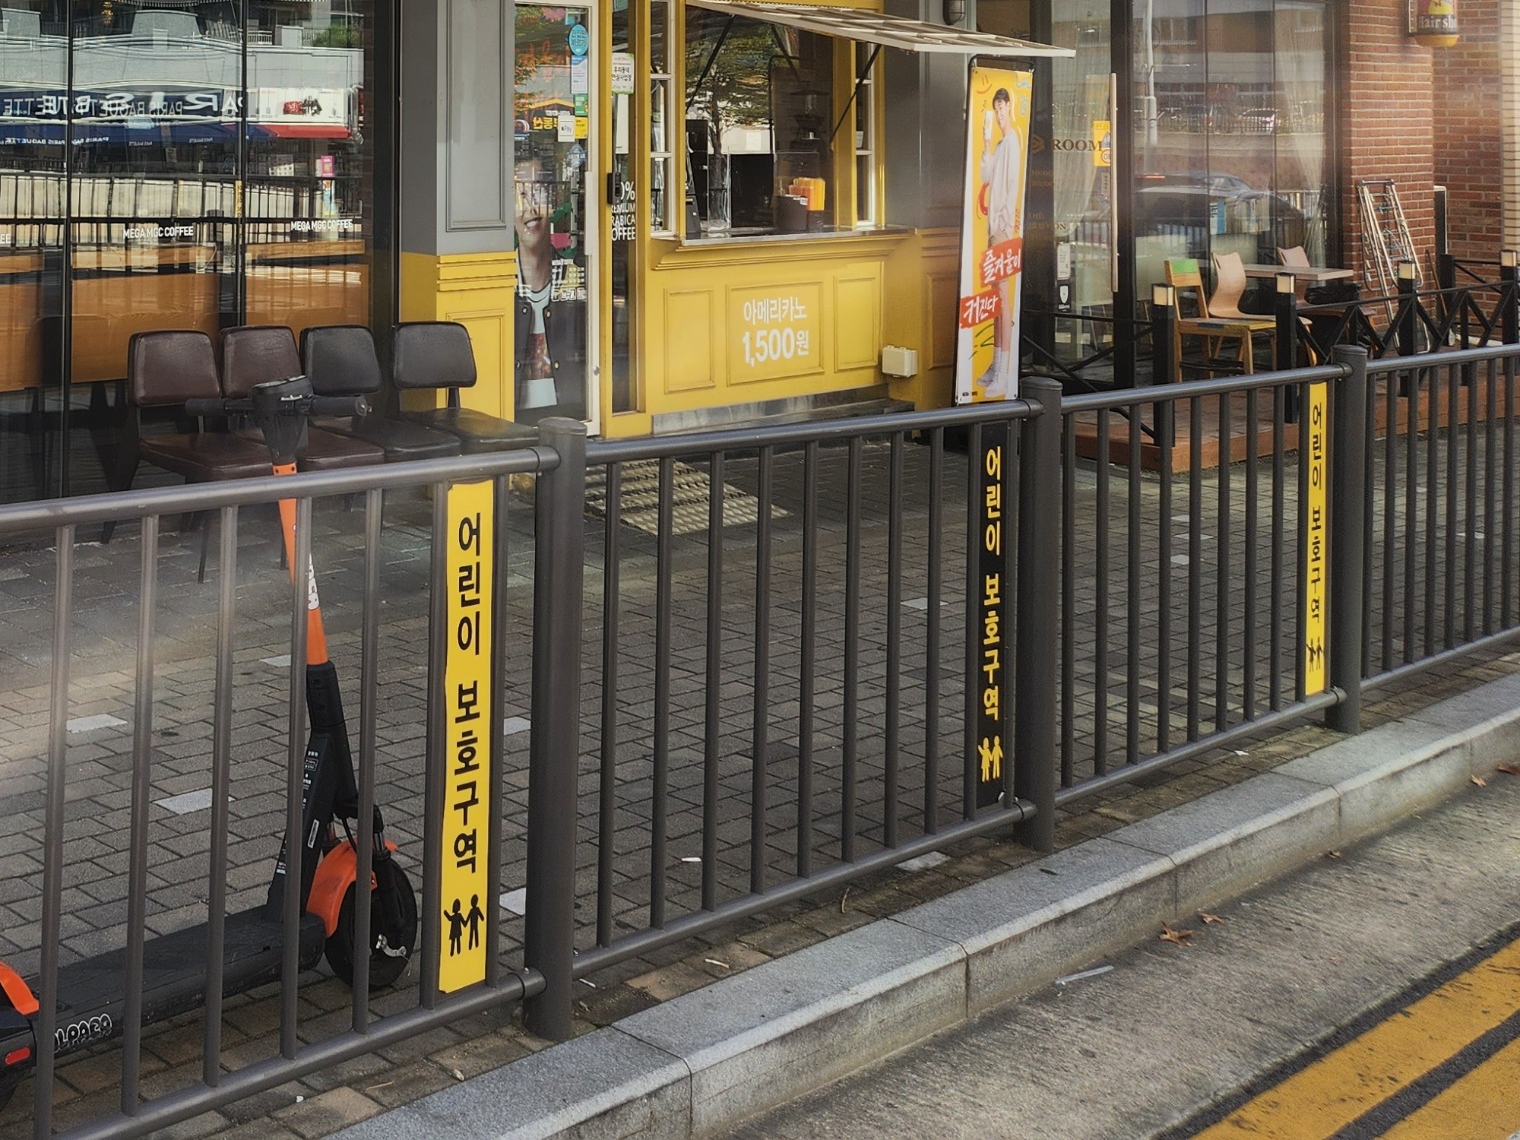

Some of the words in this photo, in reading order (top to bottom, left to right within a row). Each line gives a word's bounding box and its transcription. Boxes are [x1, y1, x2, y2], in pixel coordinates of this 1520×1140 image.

[1053, 138, 1102, 152] ROOM
[123, 228, 146, 239] MEGA
[147, 227, 164, 238] MGC
[164, 226, 194, 237] COFFEE
[291, 221, 311, 231] MEGA
[327, 218, 353, 229] COFFEE
[743, 296, 808, 326] 아메리카노
[964, 295, 999, 325] 커진다
[742, 327, 810, 367] 1,500원
[1311, 402, 1322, 490] 어린이
[986, 446, 1002, 556] 어린이
[456, 512, 482, 656] 어린이
[983, 573, 1000, 721] 보호구역
[452, 680, 480, 875] 보호구역
[55, 1013, 112, 1053] LPACA
